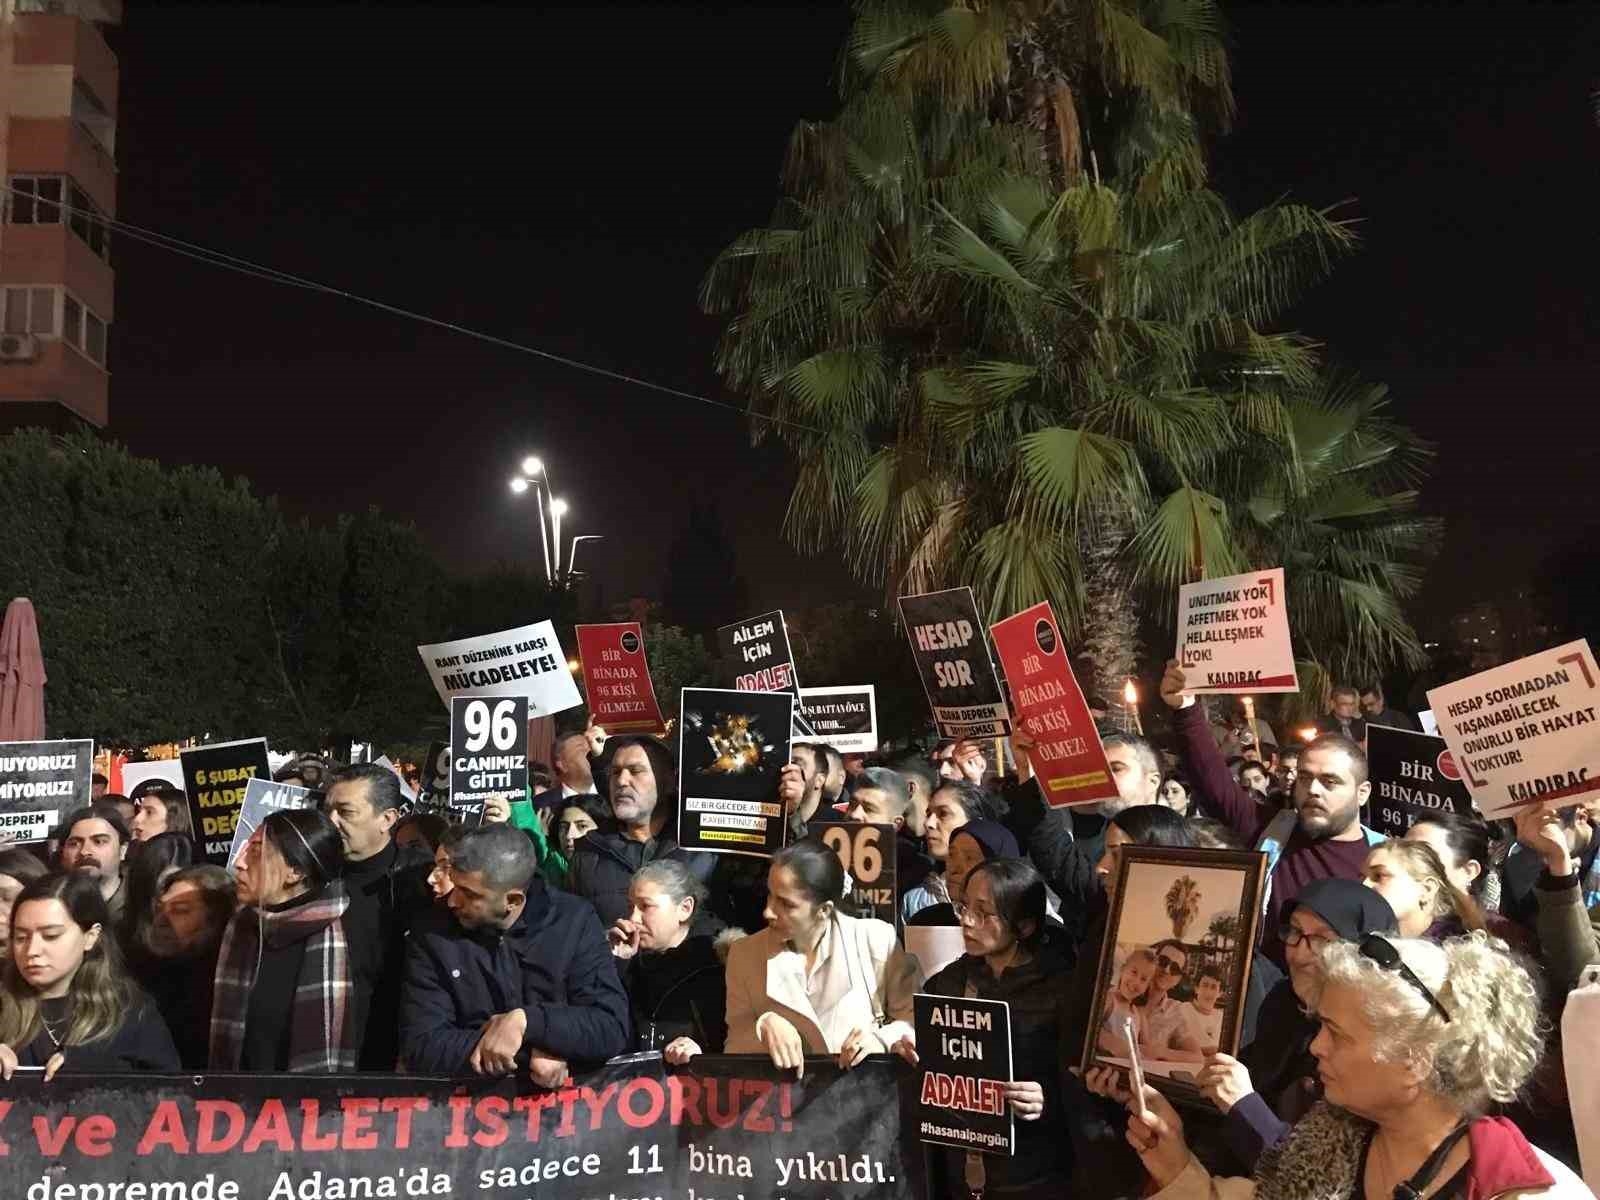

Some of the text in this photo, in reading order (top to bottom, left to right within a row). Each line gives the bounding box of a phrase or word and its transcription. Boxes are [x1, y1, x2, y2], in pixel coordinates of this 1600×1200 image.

[1188, 586, 1268, 609] UNUTMAK YOK
[1187, 605, 1268, 627] AFFETMEK YOK
[732, 620, 775, 645] AİLEM
[914, 619, 974, 651] HESAP
[1186, 625, 1265, 645] HELALLEŞMEK
[434, 636, 549, 669] RANT DÜZENİNE KARŞI
[601, 647, 622, 662] BİR
[742, 641, 773, 663] İÇİN
[1022, 651, 1044, 677] BİR
[1186, 648, 1213, 663] YOK!
[442, 653, 558, 691] MÜCADELEYE!
[592, 664, 639, 680] BİNADA
[735, 662, 793, 692] ADALET
[934, 659, 976, 688] SOR
[611, 682, 638, 698] KİŞİ
[1018, 679, 1068, 708] BİNADA
[1447, 668, 1570, 718] HESAP SORMADAN
[463, 699, 518, 753] 96
[961, 706, 997, 721] DEPREM
[1026, 705, 1072, 736] 96 KİŞİ
[1454, 694, 1561, 737] YAŞANABİLECEK
[1462, 706, 1597, 755] ONURLU BİR HAYAT
[1037, 736, 1090, 762] ÖLMEZ!
[1470, 749, 1525, 774] YOKTUR!
[194, 765, 258, 787] 6 ŞUBAT
[455, 754, 526, 773] CANIMIZ
[1399, 759, 1435, 783] BİR
[468, 769, 512, 789] GİTTİ
[197, 787, 247, 808] KADE
[259, 787, 309, 810] AİLE
[1379, 780, 1456, 813] BİNADA
[201, 814, 241, 837] DEĞ
[1381, 807, 1403, 827] 96
[853, 888, 893, 905] IMIZ
[929, 1003, 993, 1032] AİLEM
[941, 1032, 984, 1061] İÇİN
[920, 1070, 1007, 1116] ADALET
[31, 1113, 117, 1158] ve
[136, 1096, 430, 1156] ADALET
[443, 1076, 794, 1149] İSTİYORUZ!
[920, 1121, 1009, 1148] #hasanalpargün
[27, 1144, 896, 1200] depremde Adana'da sadece 11 bina yıkıldı.
